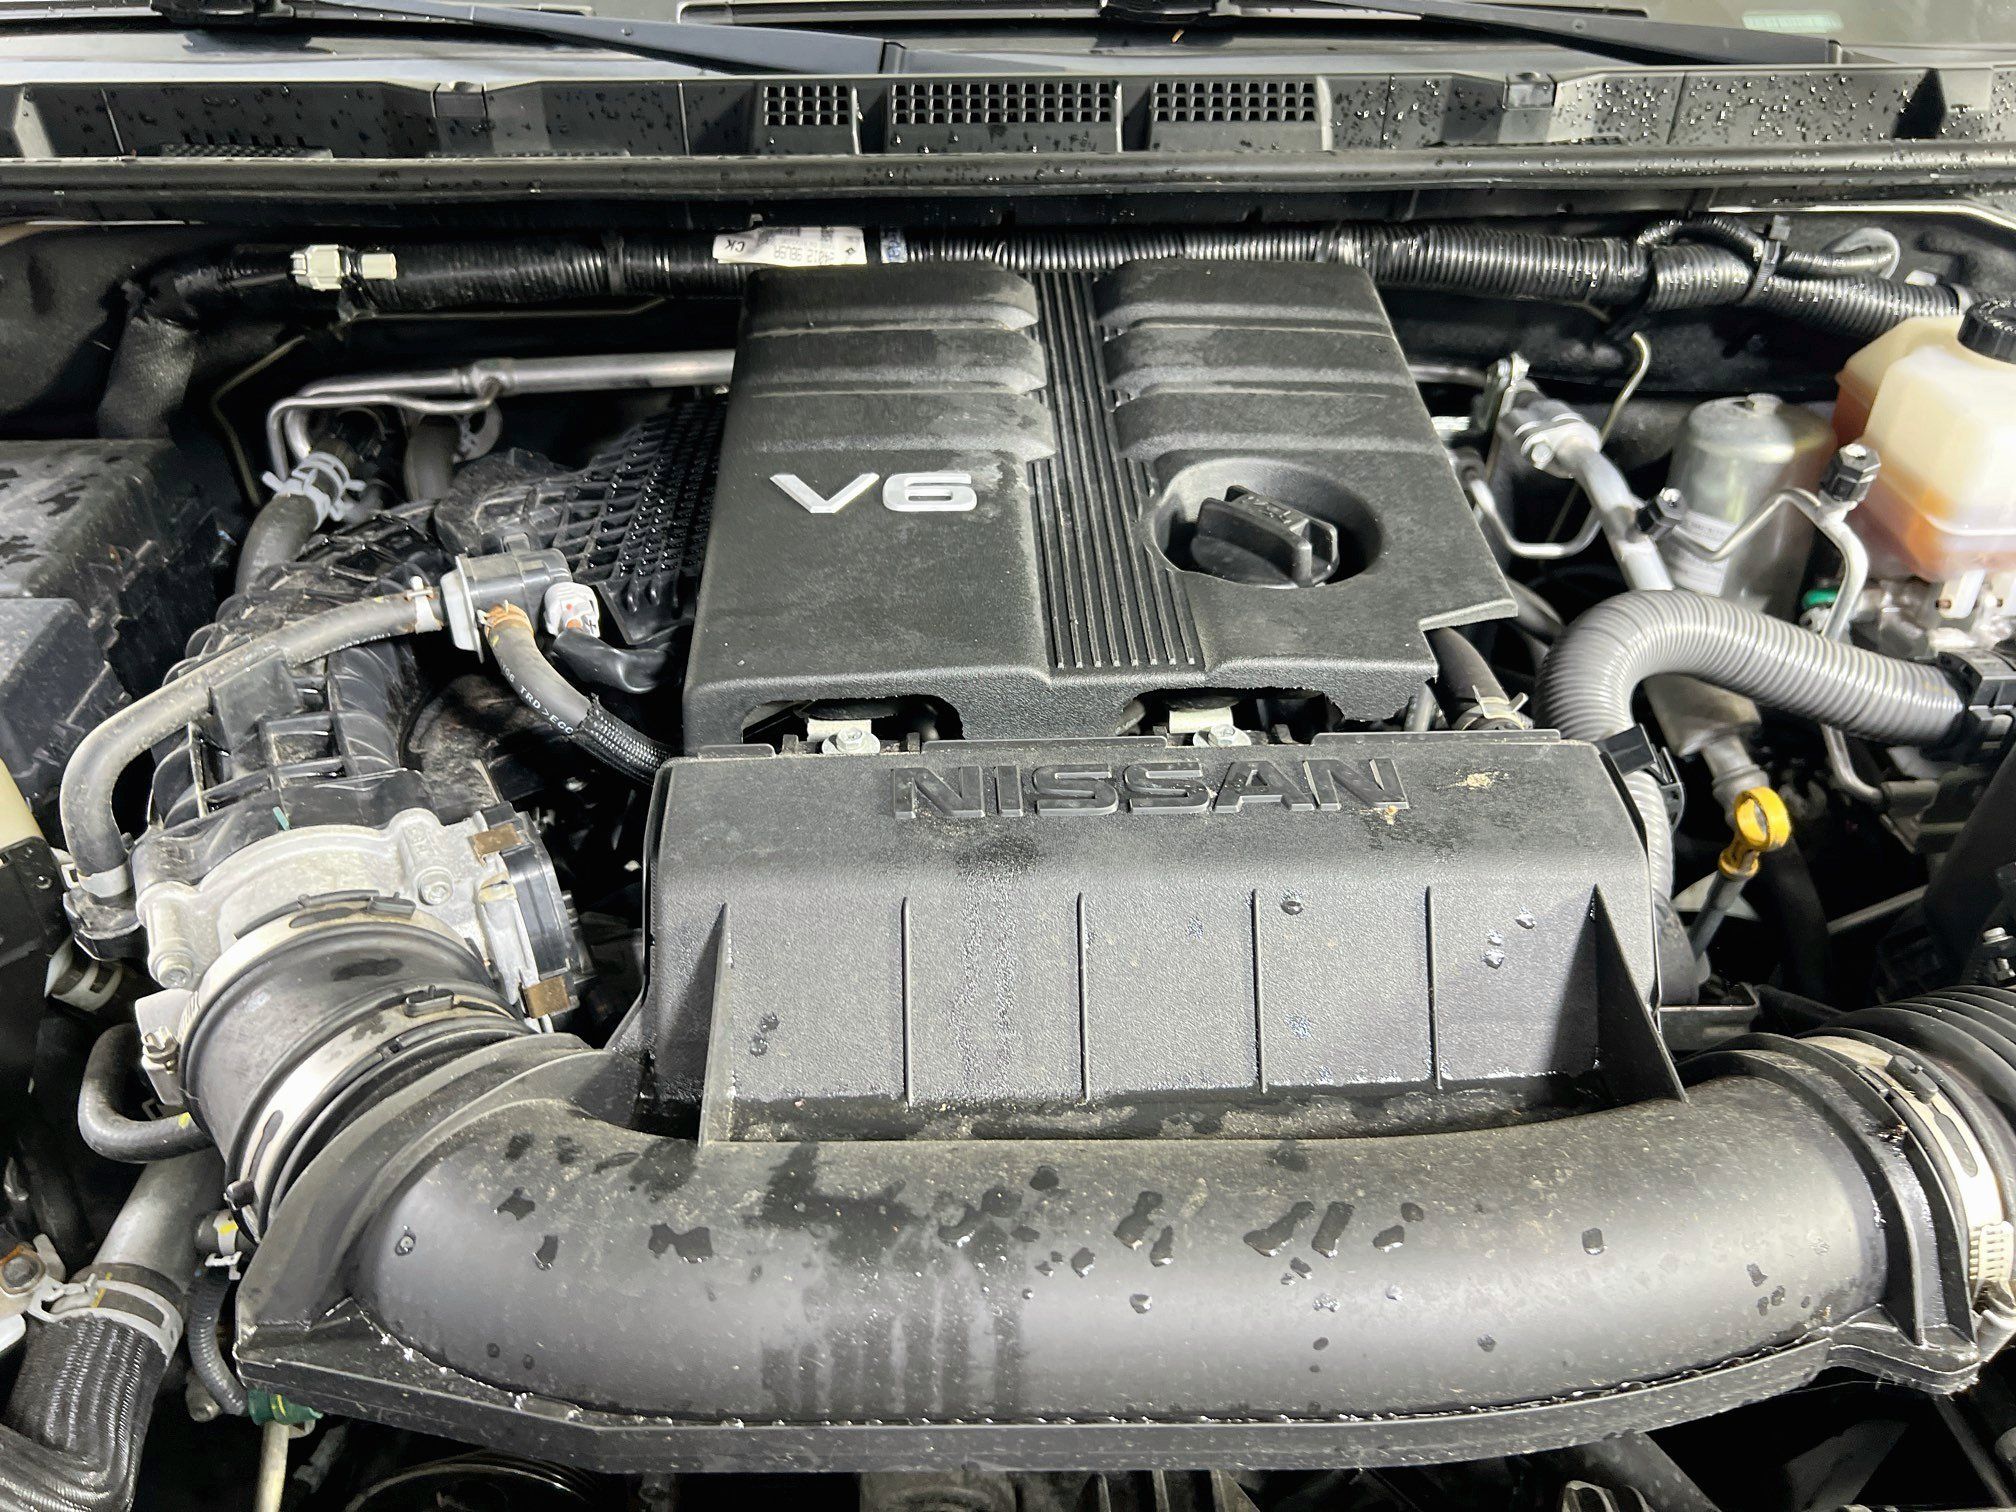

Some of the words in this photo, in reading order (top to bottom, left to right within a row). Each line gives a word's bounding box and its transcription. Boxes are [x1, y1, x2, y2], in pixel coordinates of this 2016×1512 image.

[725, 238, 745, 252] CK
[769, 472, 977, 514] V6
[891, 757, 1408, 819] NISSAN
